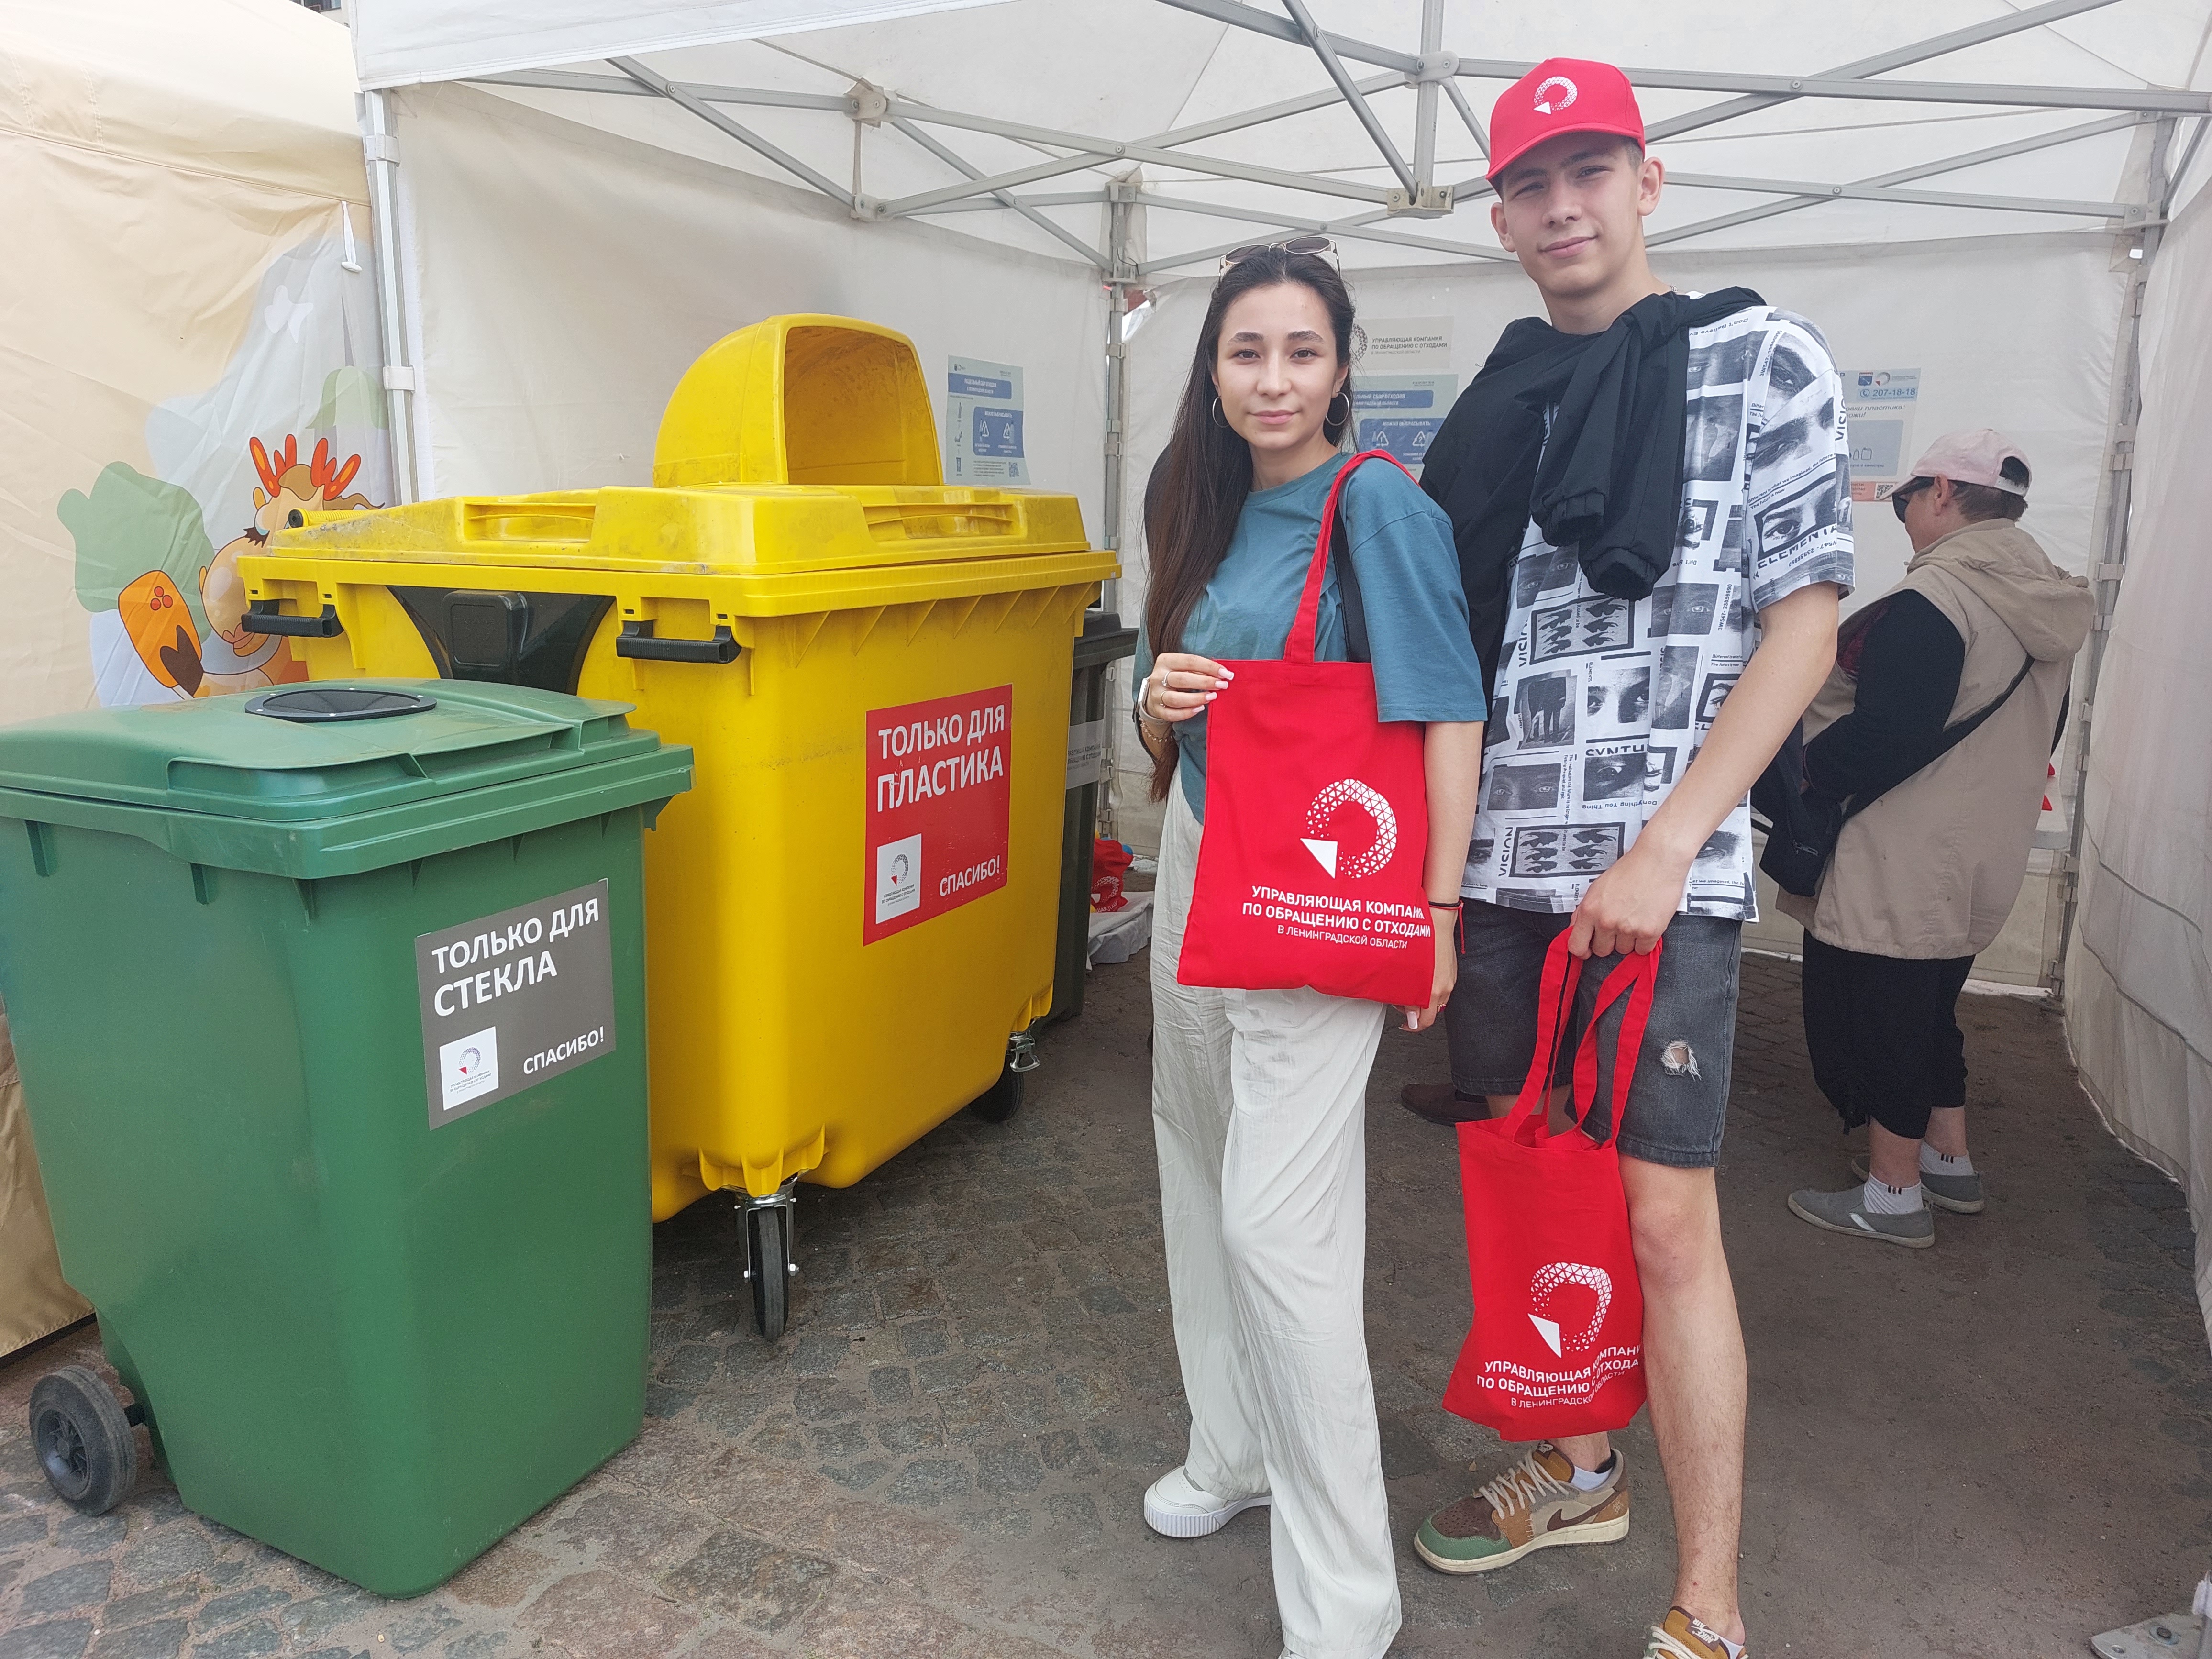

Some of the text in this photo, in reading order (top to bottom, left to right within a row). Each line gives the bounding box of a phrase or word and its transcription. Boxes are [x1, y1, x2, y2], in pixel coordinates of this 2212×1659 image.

[1872, 387, 1916, 397] 207-18-18
[878, 704, 1005, 760] ТОЛЬКО ДЛЯ
[877, 745, 1004, 812] ПЛАСТИКА
[939, 854, 1000, 897] СПАСИБО!
[1251, 885, 1361, 913] УПРАВЛЯЮЩАЯ
[431, 898, 599, 973] ТОЛЬКО ДЛЯ
[1242, 902, 1431, 938] ПО ОБРАЩЕНИЮ С ОТХОДАМИ
[1277, 925, 1408, 950] В ЛЕНИНГРАДСКОЙ ОБЛАСТИ
[434, 950, 557, 1016] СТЕКЛА
[523, 1026, 604, 1074] СПАСИБО!
[1477, 1375, 1494, 1389] ПО
[1498, 1378, 1590, 1397] ОБРАЩЕНИЮ
[1592, 1376, 1596, 1387] С
[1485, 1361, 1591, 1383] УПРАВЛЯЮЩАЯ
[1511, 1397, 1517, 1407] В
[1594, 1371, 1626, 1394] ОБЛАСТИ
[1692, 1617, 1706, 1629] AIR
